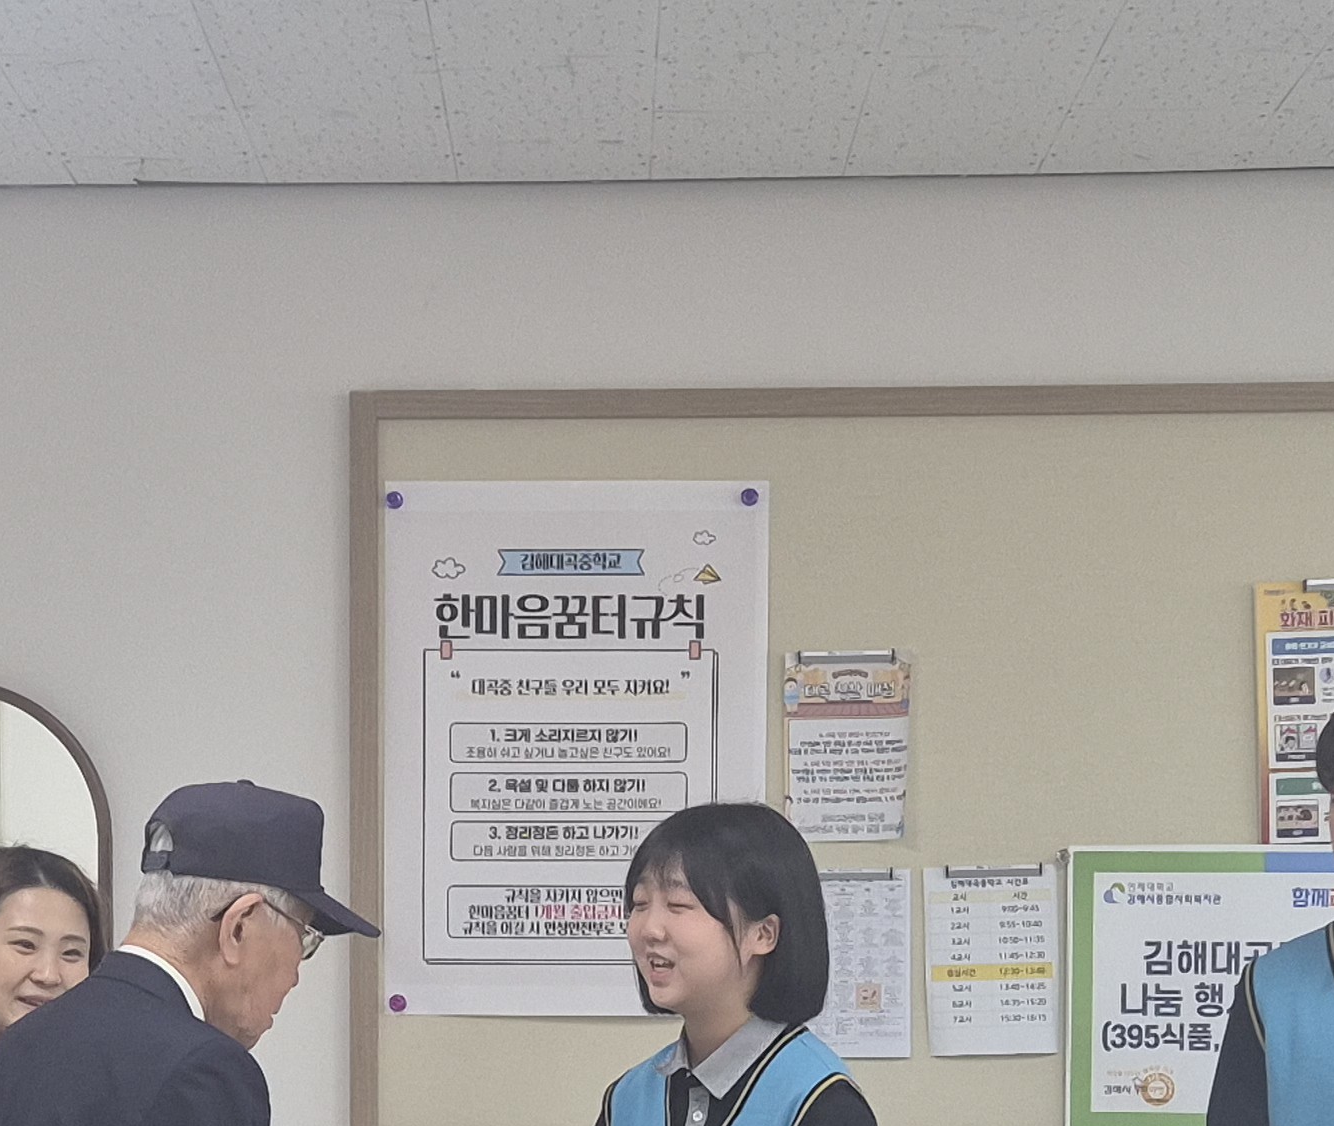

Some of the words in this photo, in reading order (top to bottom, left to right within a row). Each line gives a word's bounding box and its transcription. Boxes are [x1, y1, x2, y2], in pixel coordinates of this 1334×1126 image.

[519, 552, 622, 571] 김해대곡중학교
[433, 593, 705, 640] 한마음꿈터규칙
[1280, 609, 1313, 627] 화재
[471, 679, 512, 696] 대곡중
[516, 679, 557, 696] 친구들
[561, 679, 588, 696] 우리
[592, 679, 619, 696] 모두
[490, 729, 500, 742] 1.
[504, 728, 531, 743] 크게
[535, 728, 602, 743] 소리지르지
[606, 728, 638, 743] 않기!
[603, 747, 633, 758] 친구도
[488, 779, 501, 792] 2.
[583, 778, 609, 793] 하지
[488, 826, 502, 840] 3.
[505, 826, 559, 840] 정리정돈
[562, 826, 589, 840] 하고
[593, 826, 639, 840] 나가기!
[598, 845, 619, 857] 하고
[504, 888, 542, 903] 규칙을
[545, 888, 581, 903] 지키지
[463, 920, 497, 935] 규칙을
[528, 921, 540, 935] 시
[1120, 982, 1183, 1017] 나눔
[1194, 981, 1230, 1018] 행
[1101, 1021, 1220, 1053] (395식품,
